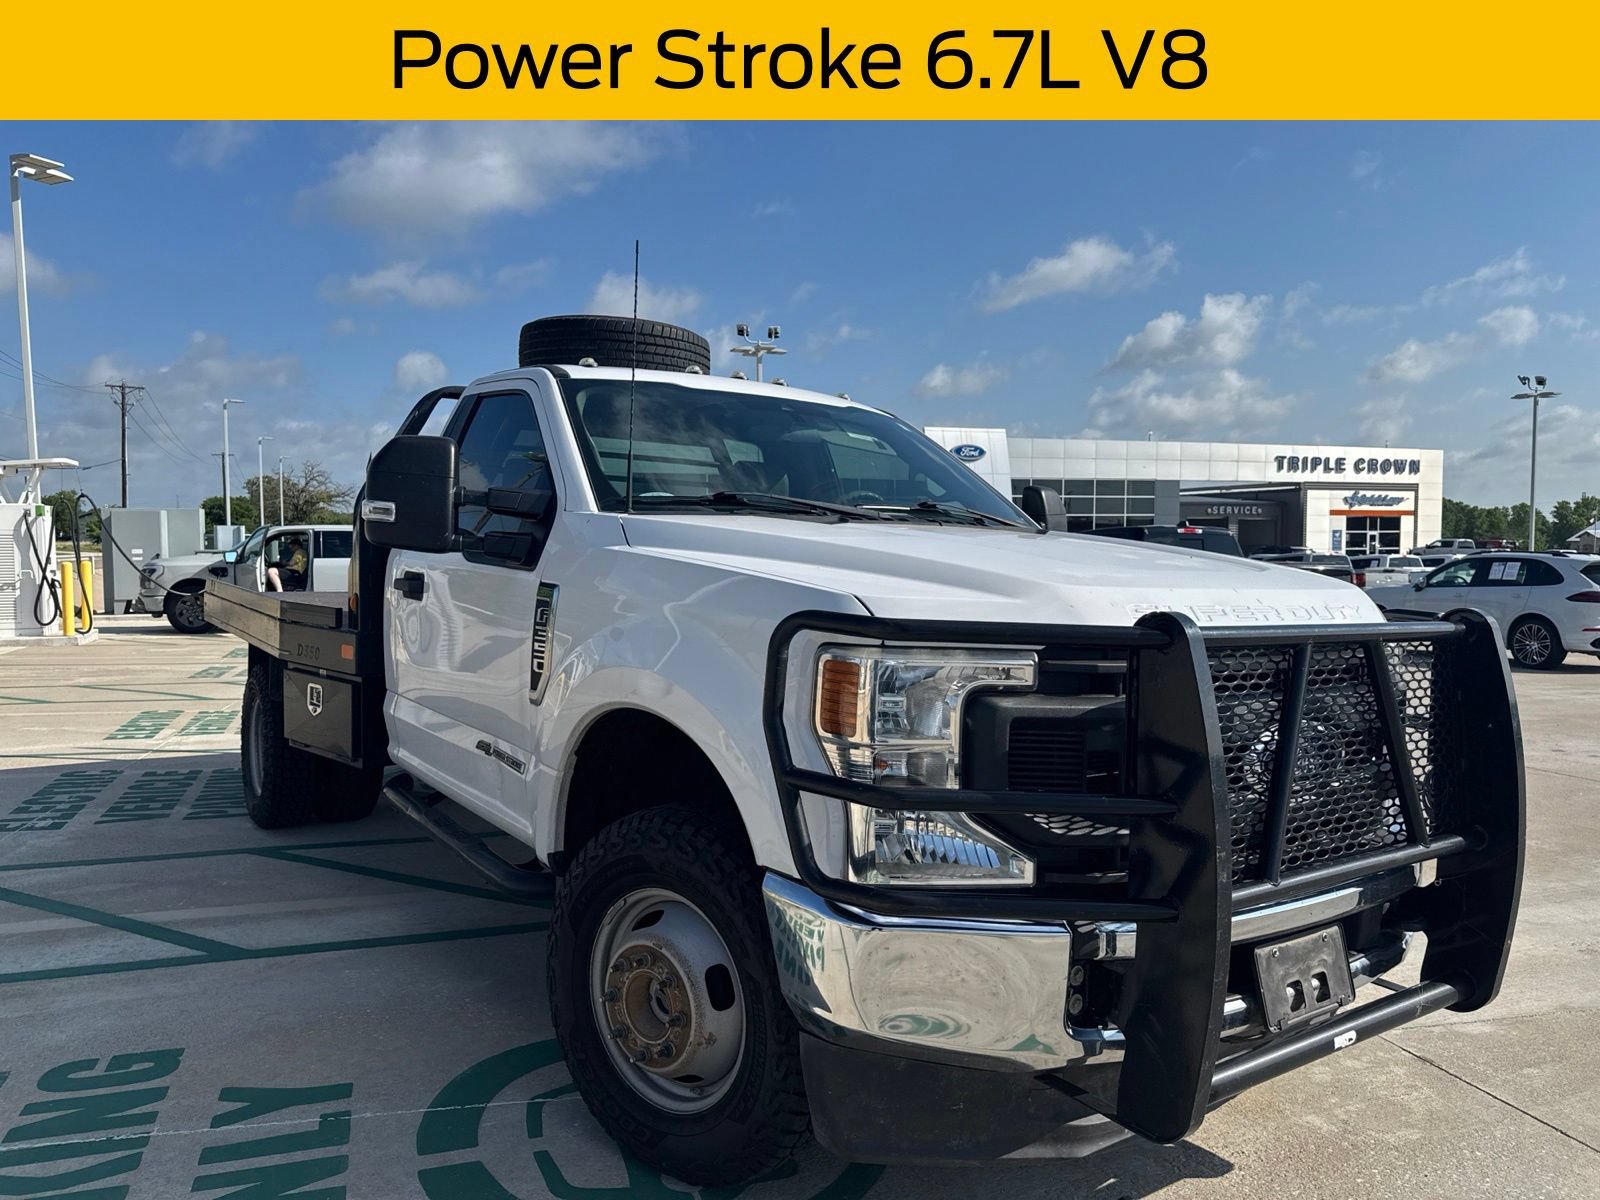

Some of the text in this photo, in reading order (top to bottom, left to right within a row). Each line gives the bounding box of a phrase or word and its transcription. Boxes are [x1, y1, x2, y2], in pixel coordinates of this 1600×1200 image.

[1275, 455, 1420, 475] TRIPLE CROWN
[1212, 505, 1258, 514] SERVICE
[1288, 602, 1363, 622] DUTY
[0, 769, 125, 832] ELECTRIC
[94, 769, 203, 825] VEHICLE
